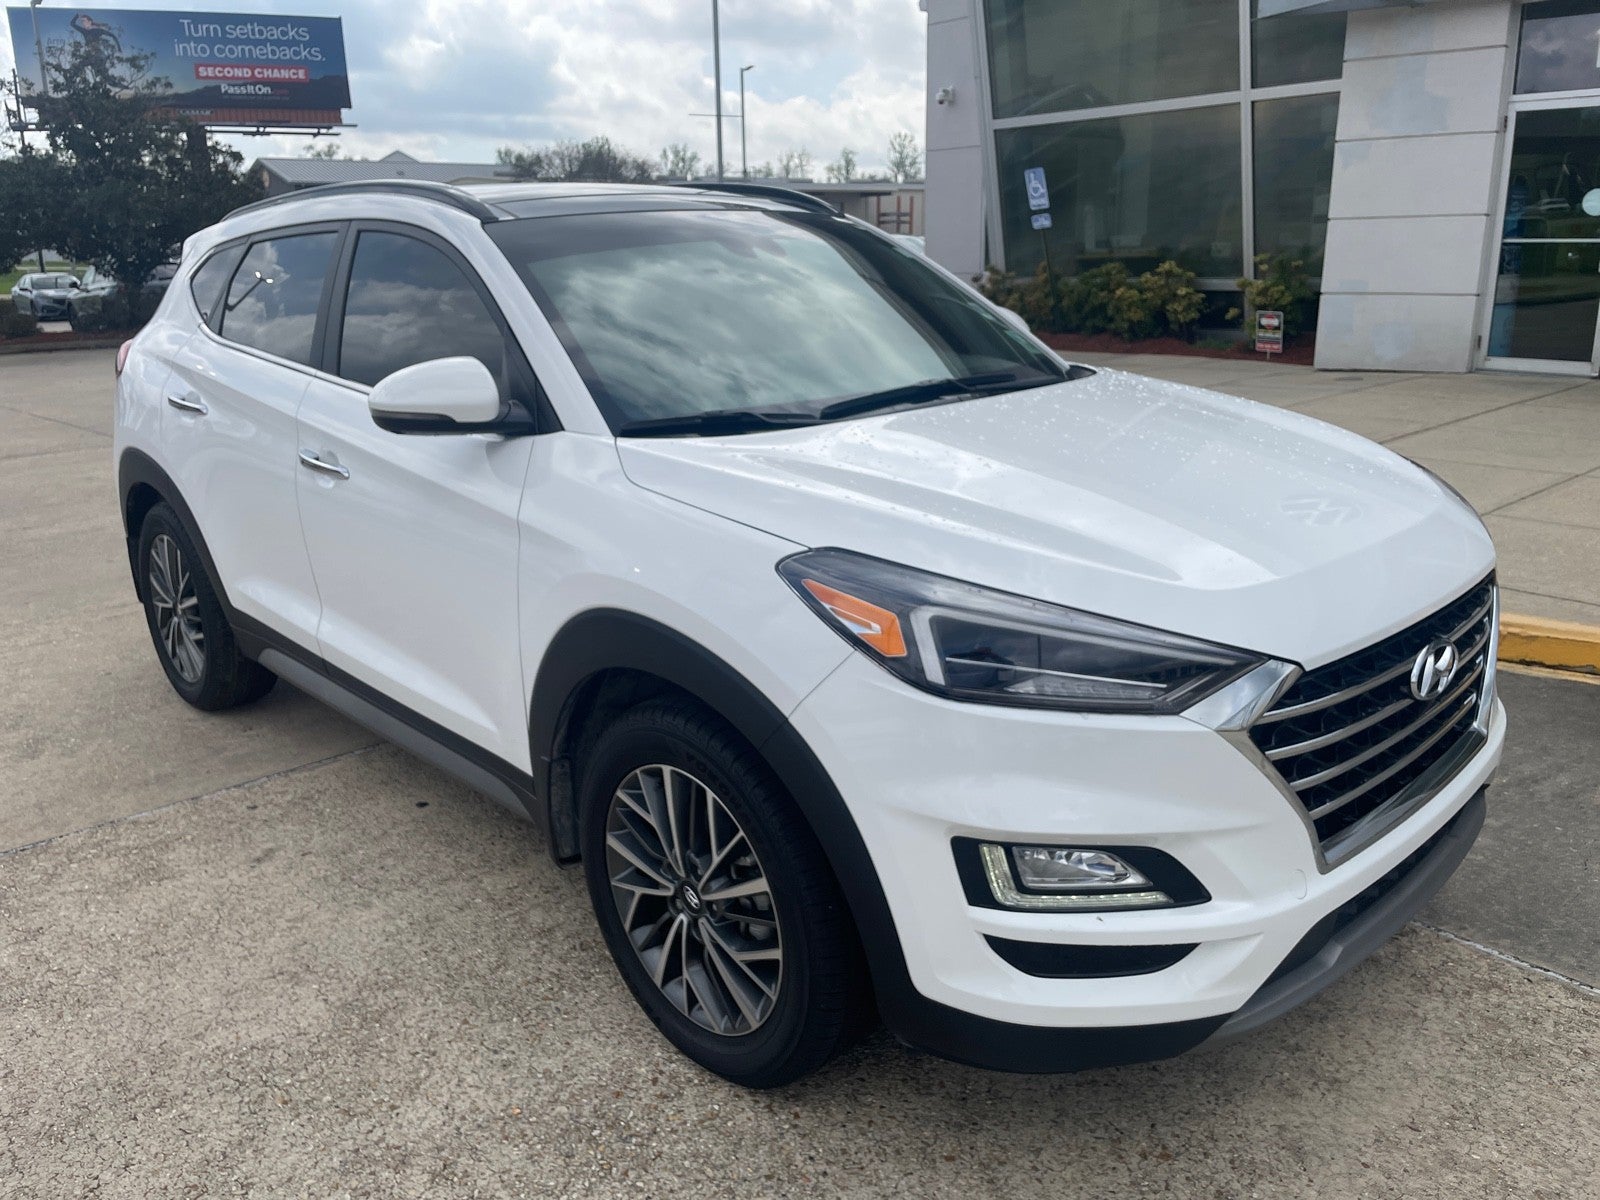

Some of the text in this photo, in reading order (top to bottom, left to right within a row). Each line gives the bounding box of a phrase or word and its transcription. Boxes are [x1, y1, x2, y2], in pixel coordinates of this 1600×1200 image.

[179, 19, 310, 41] Turn setbacks
[174, 39, 326, 62] into comebacks.
[198, 66, 306, 79] SECOND CHANCE
